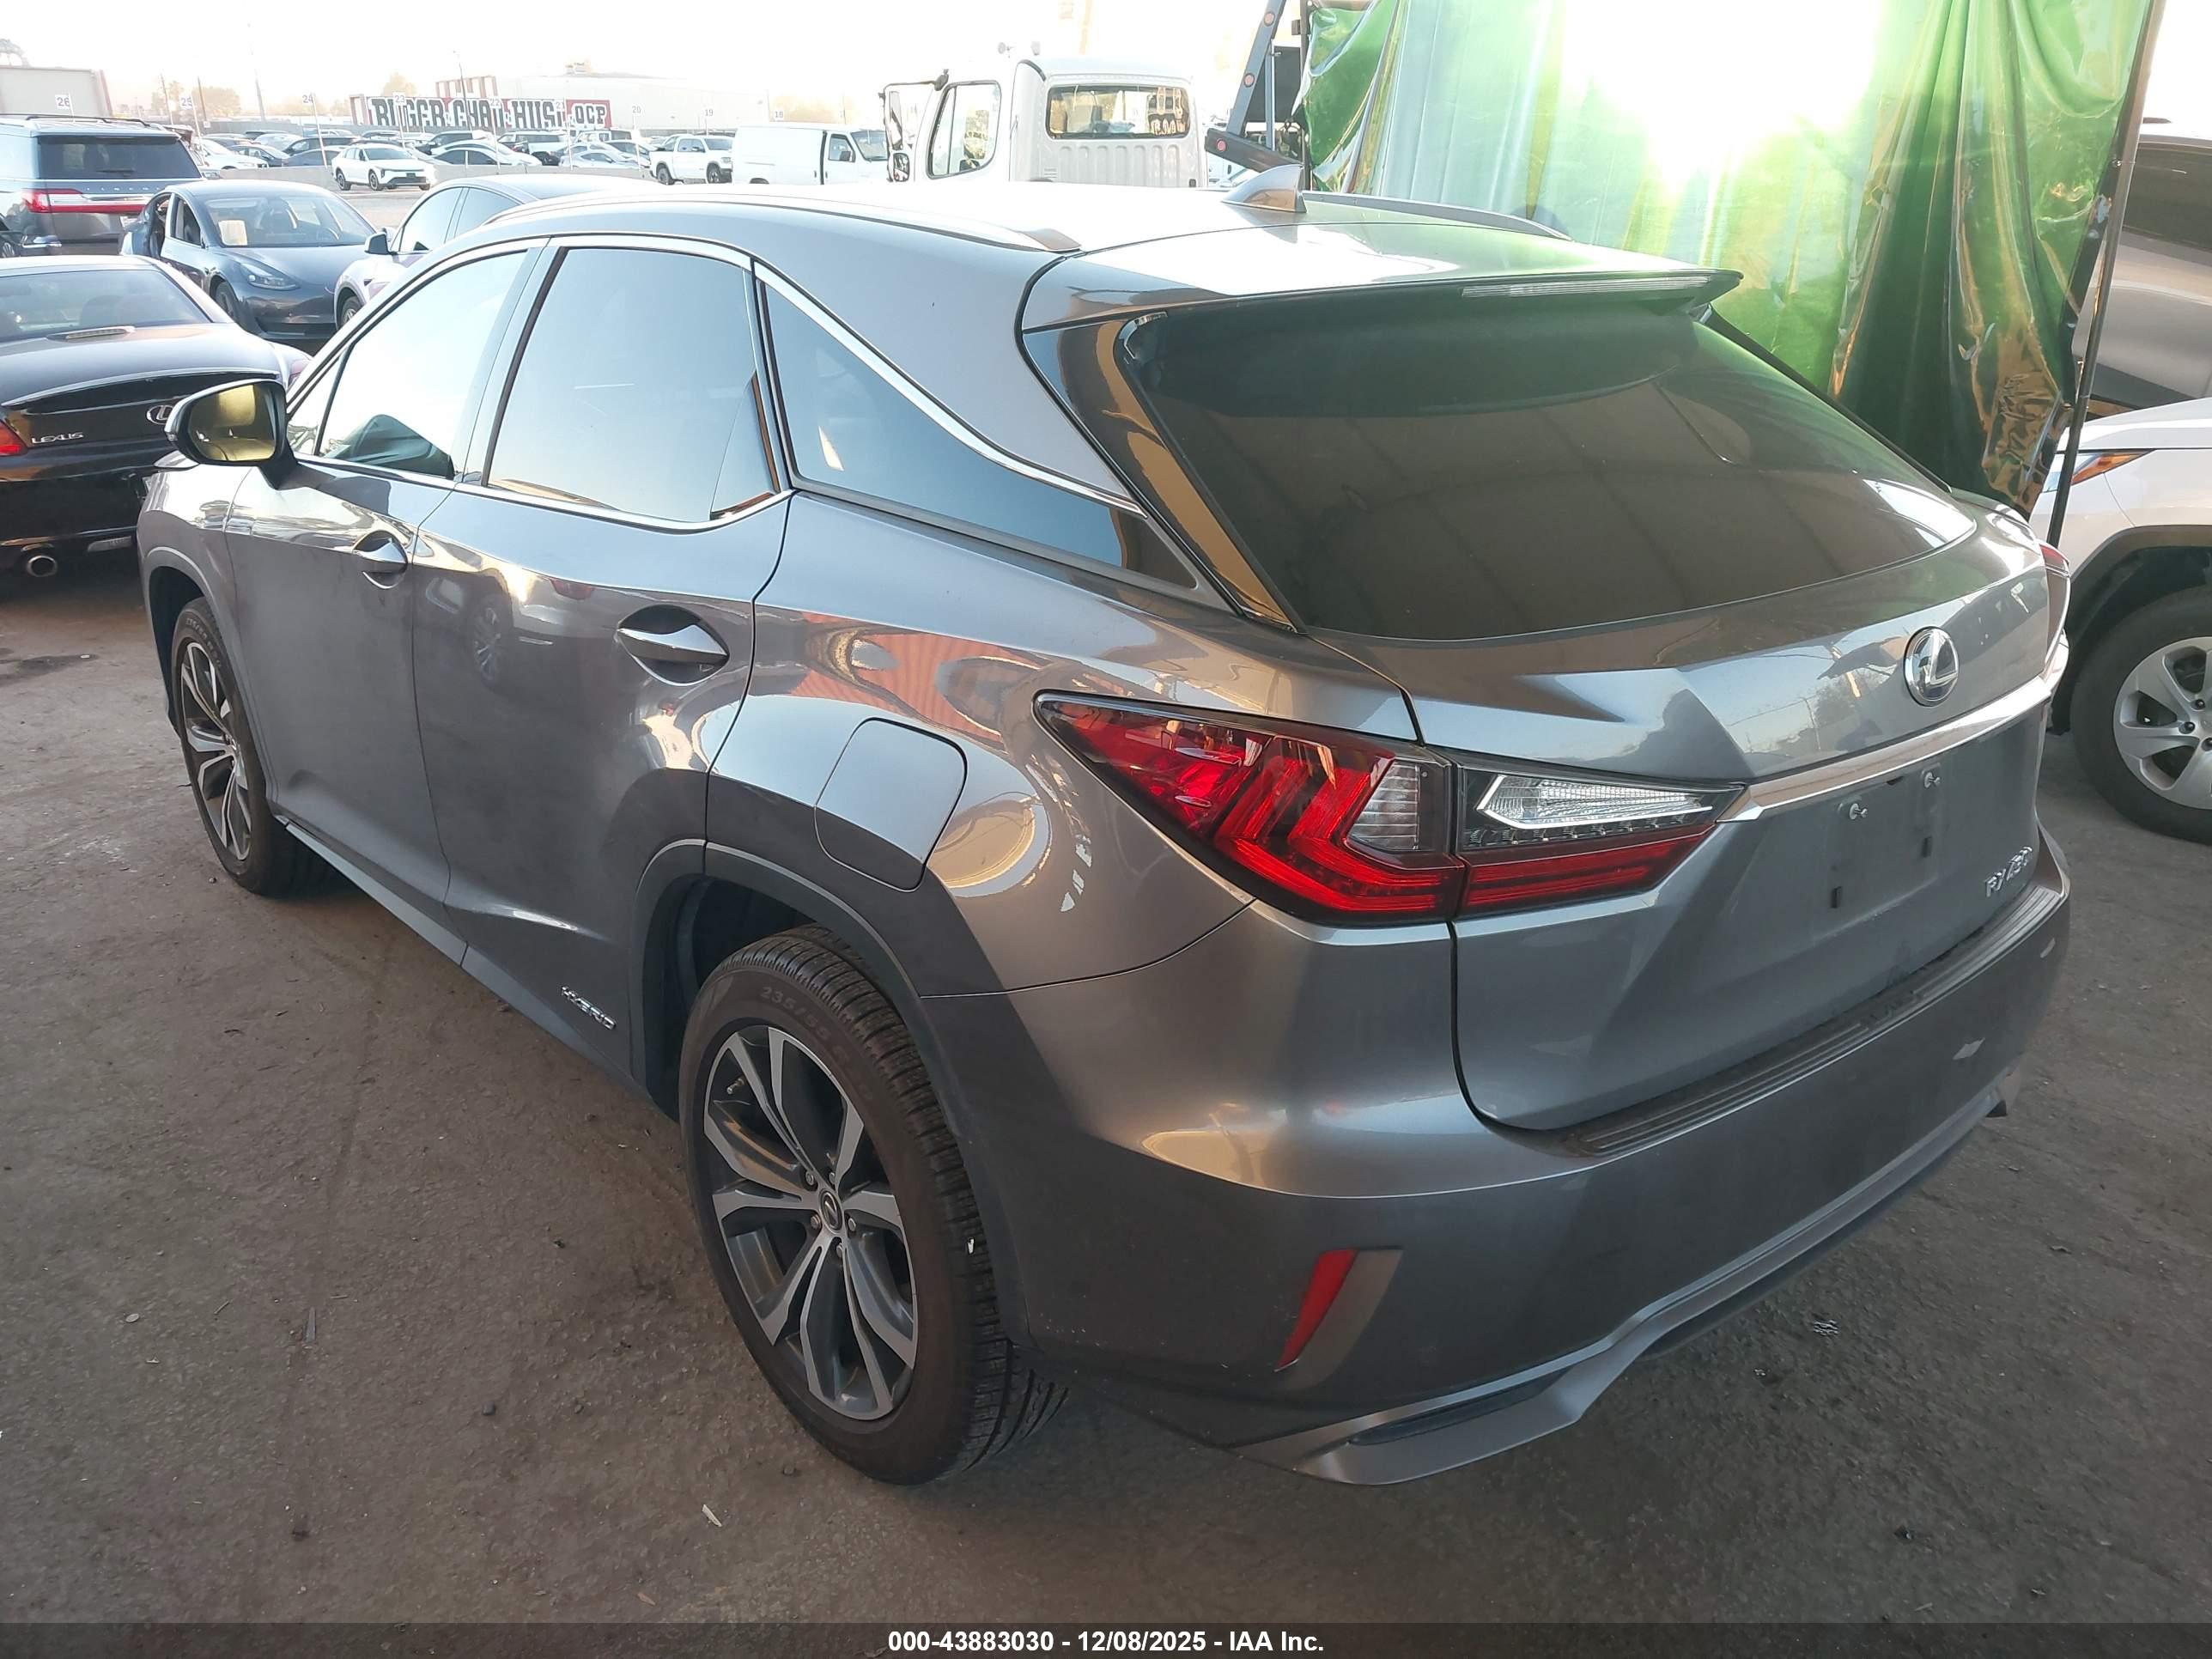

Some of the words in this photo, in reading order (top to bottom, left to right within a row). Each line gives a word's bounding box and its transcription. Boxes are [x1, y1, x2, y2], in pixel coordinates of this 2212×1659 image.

[57, 96, 70, 107] 26
[180, 97, 192, 106] 25
[394, 94, 405, 103] 23
[574, 105, 606, 125] OCP
[704, 108, 714, 117] 19
[31, 431, 84, 444] LEXUS
